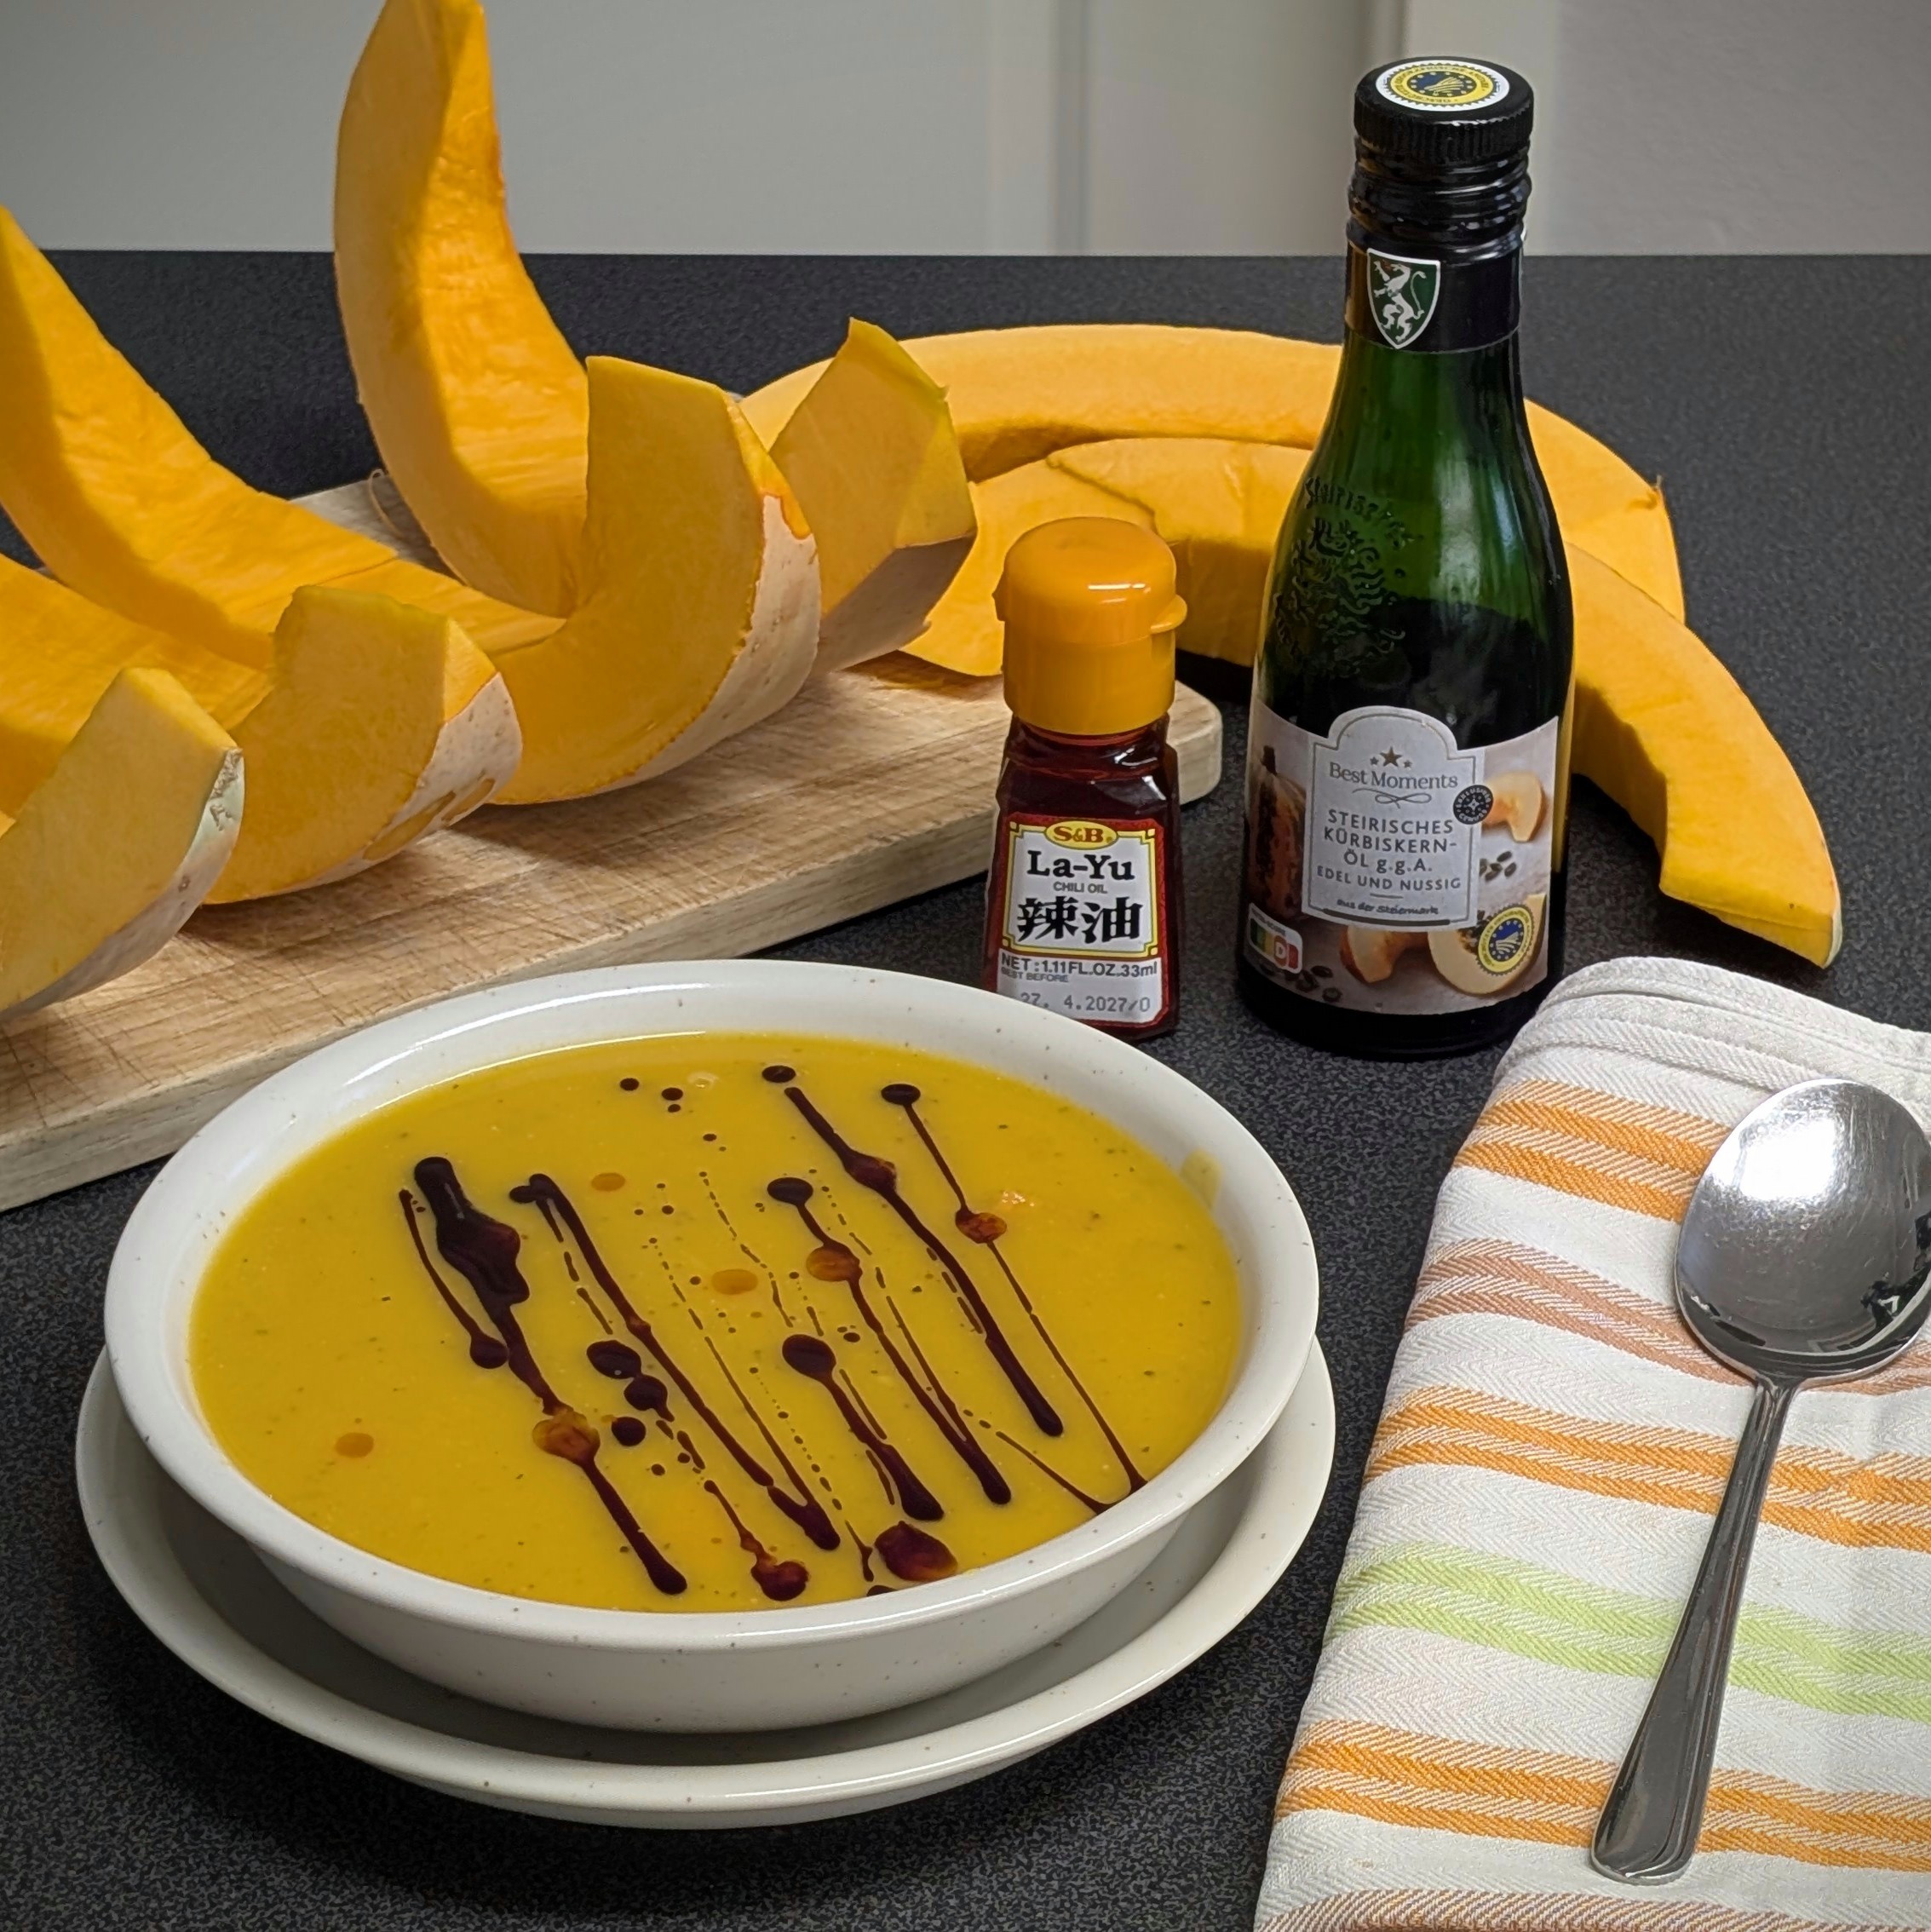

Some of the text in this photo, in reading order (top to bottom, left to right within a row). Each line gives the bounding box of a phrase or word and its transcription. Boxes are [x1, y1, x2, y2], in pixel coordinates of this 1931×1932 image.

[1329, 761, 1458, 790] Best Moments
[1053, 825, 1105, 843] S&B
[1327, 808, 1454, 835] STEIRISCHES
[1026, 849, 1135, 881] La-Yu
[1342, 848, 1433, 876] ÖL g.g.A.
[1053, 881, 1108, 894] CHILI OIL
[1317, 865, 1352, 884] EDEL
[1357, 874, 1393, 890] UND
[1016, 895, 1143, 944] 辣油
